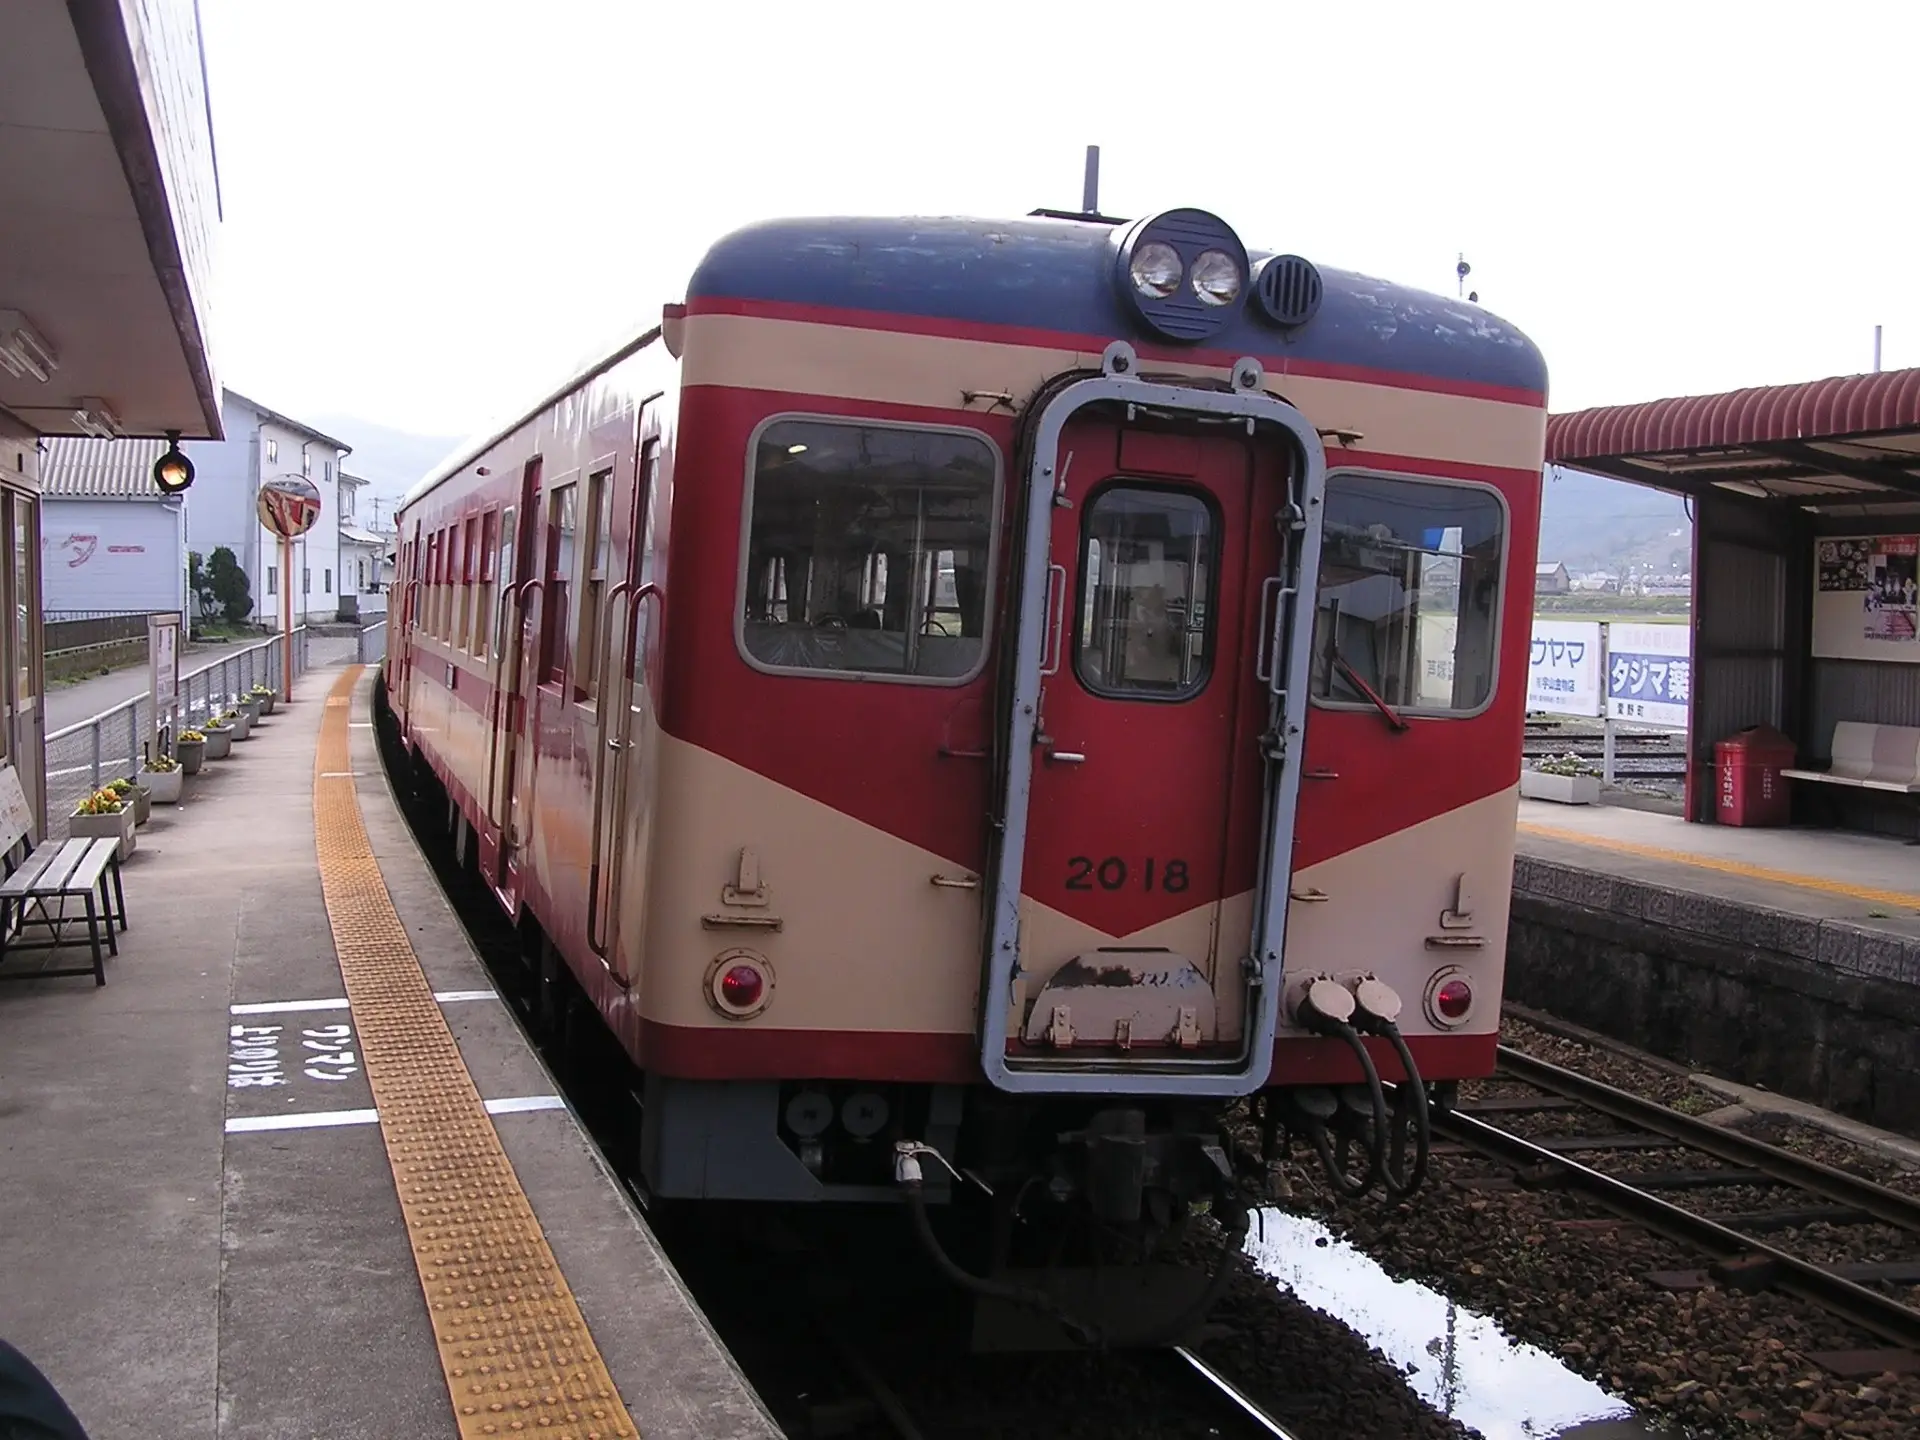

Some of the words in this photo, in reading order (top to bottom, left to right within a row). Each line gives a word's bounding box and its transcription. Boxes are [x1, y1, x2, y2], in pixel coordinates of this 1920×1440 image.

[43, 532, 146, 568] ター
[1065, 856, 1190, 893] 2018
[228, 1024, 291, 1088] 上りのりば
[302, 1024, 357, 1080] ワンマン
